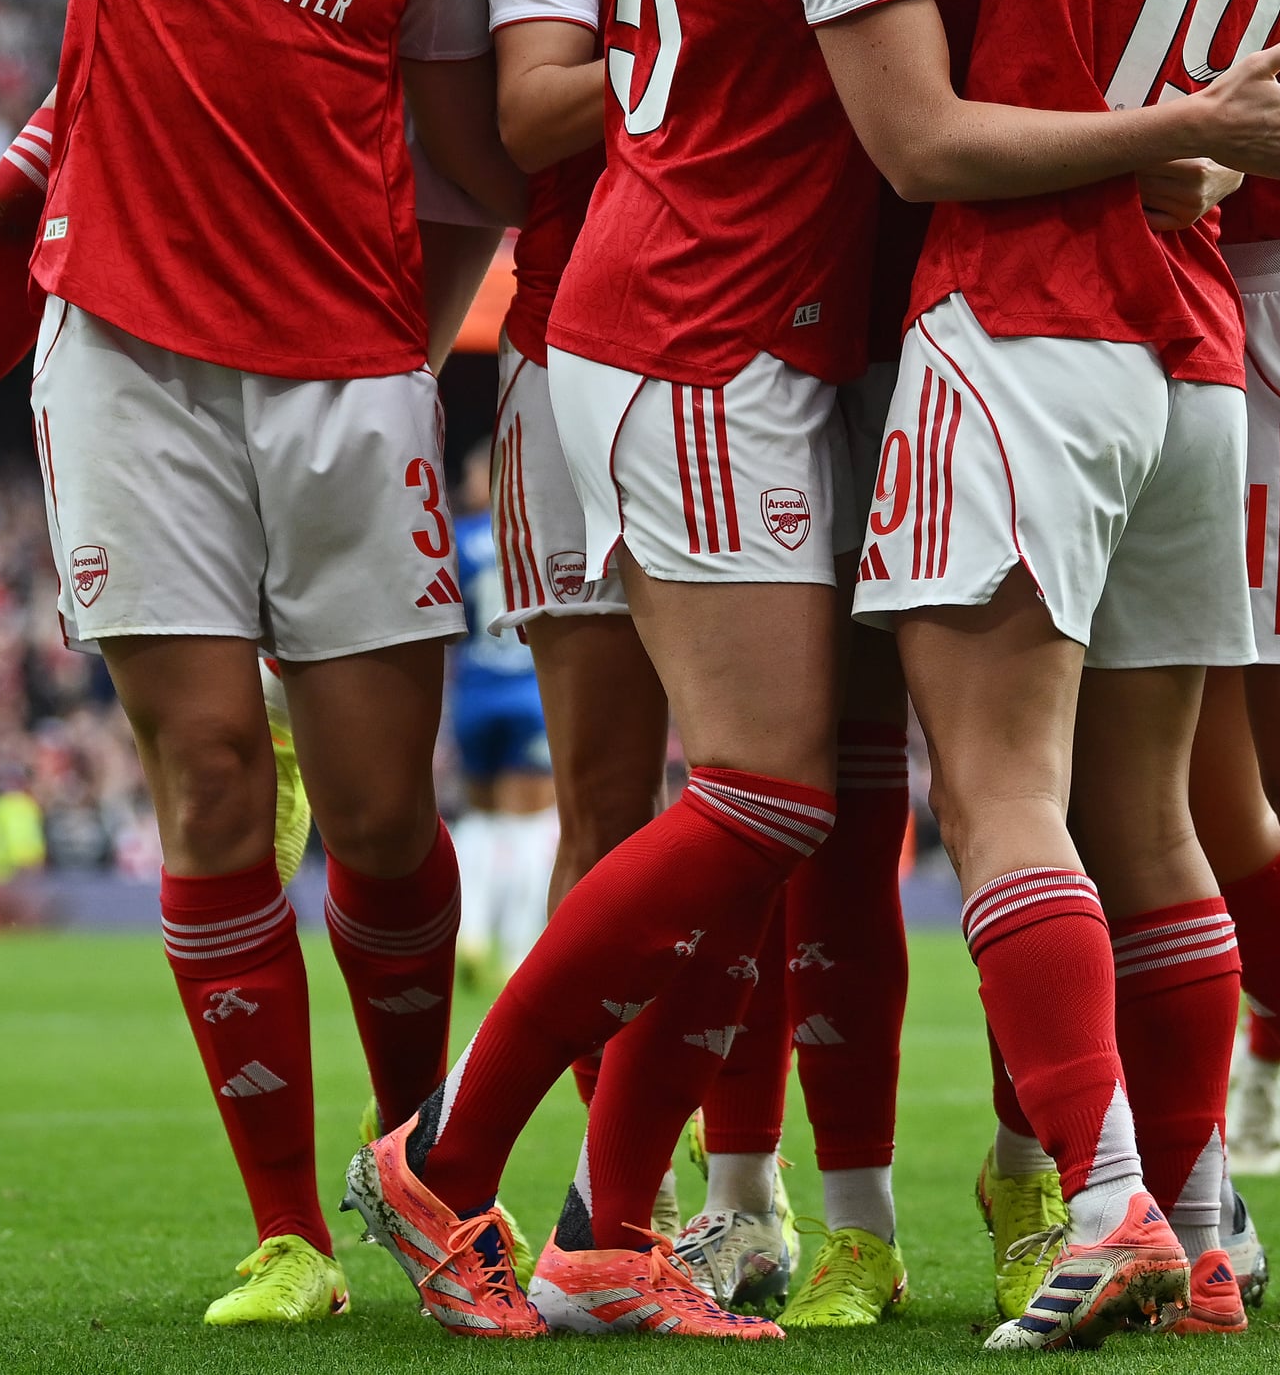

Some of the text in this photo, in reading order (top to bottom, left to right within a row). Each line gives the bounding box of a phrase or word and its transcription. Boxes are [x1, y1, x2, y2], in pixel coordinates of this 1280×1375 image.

[405, 457, 450, 559] 3
[768, 498, 803, 508] Arsenal
[73, 555, 100, 567] Arsenal
